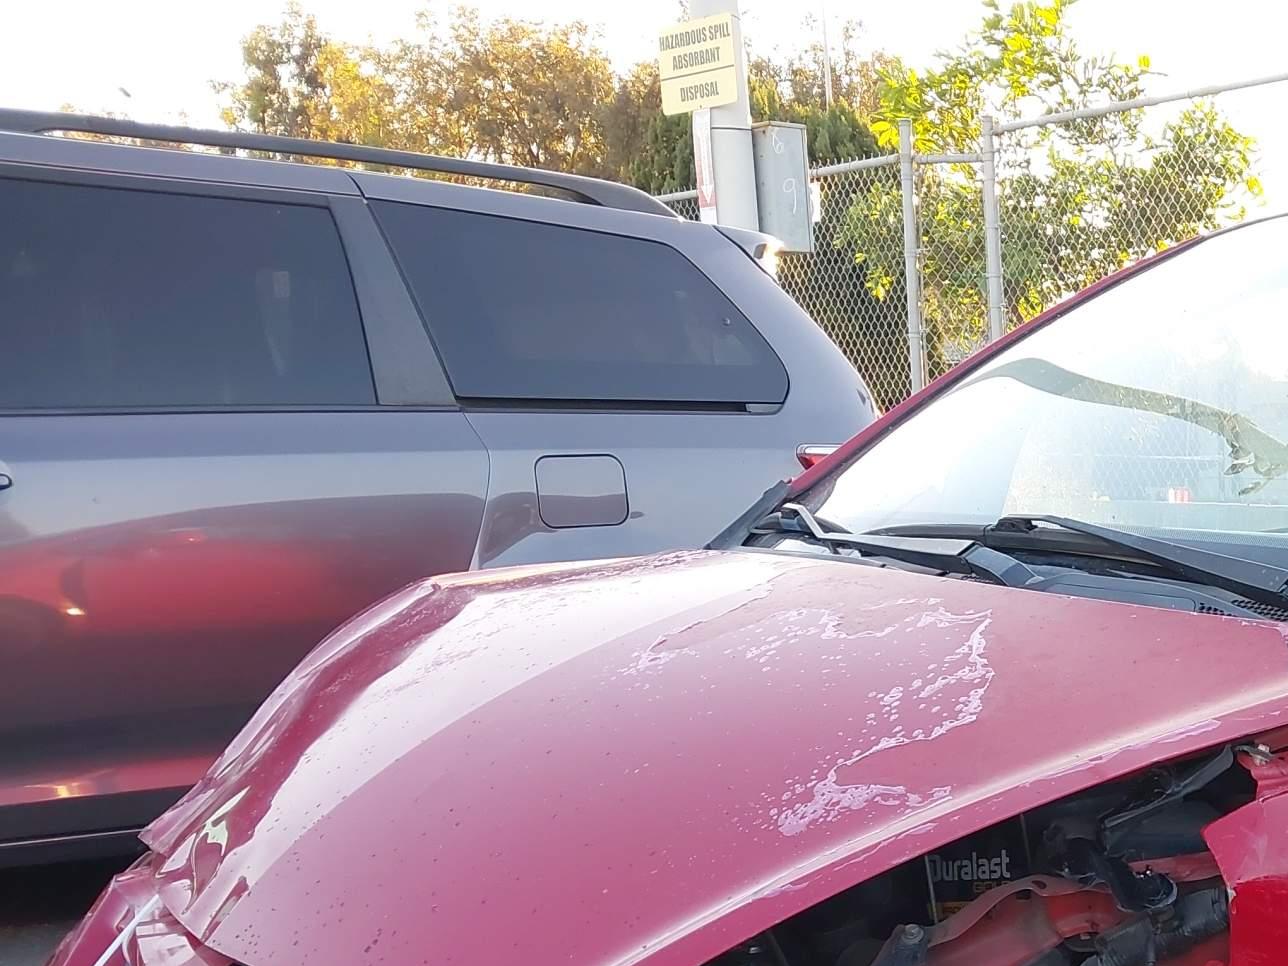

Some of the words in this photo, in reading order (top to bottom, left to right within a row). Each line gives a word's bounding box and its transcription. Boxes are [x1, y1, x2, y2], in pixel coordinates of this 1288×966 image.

[659, 29, 708, 51] HAZARDOUS
[708, 22, 731, 42] SPILL
[673, 47, 720, 71] ABSORBANT
[680, 81, 719, 102] DISPOSAL
[929, 849, 1011, 881] Duralast
